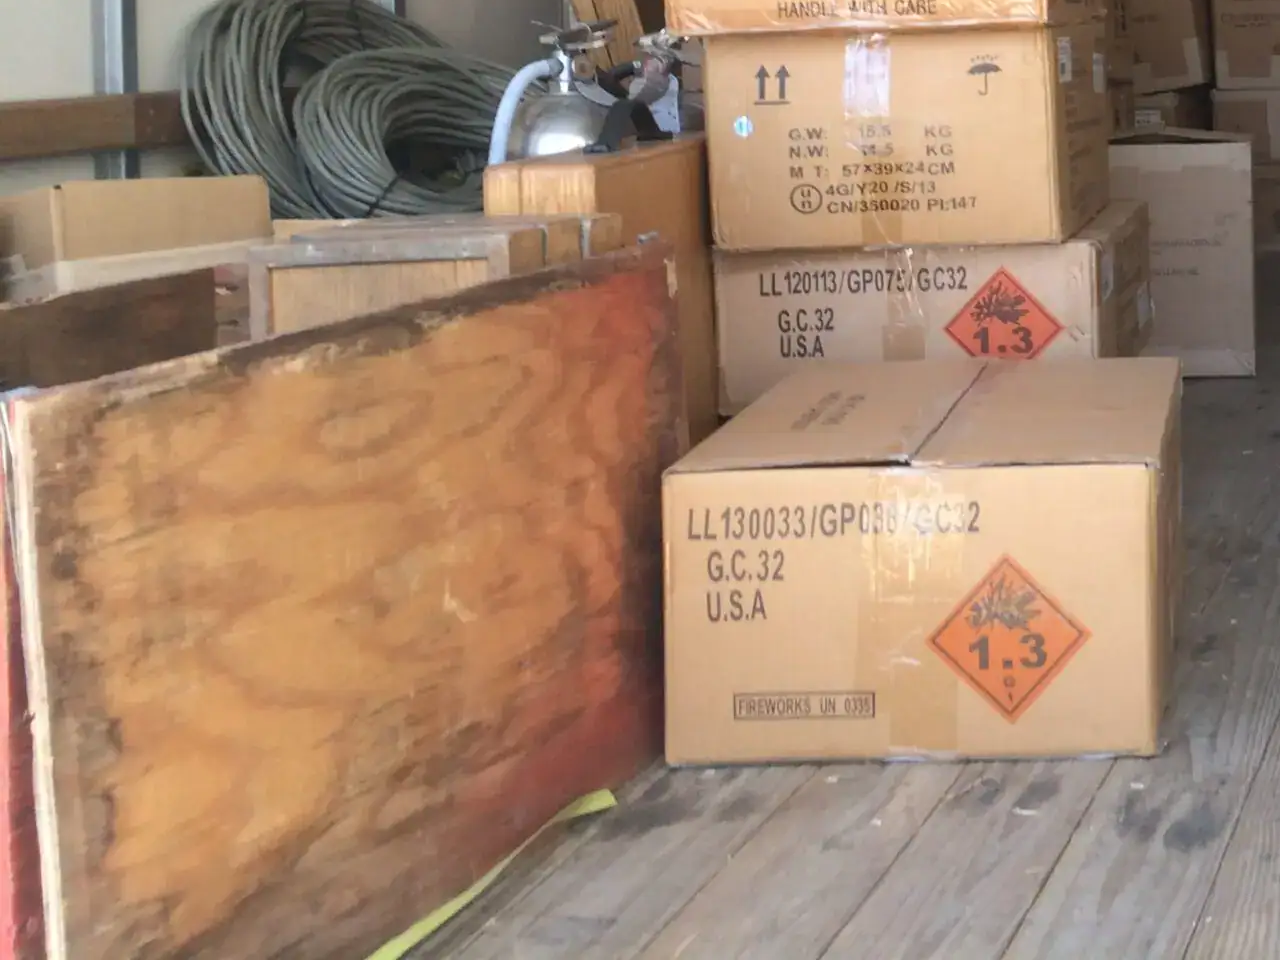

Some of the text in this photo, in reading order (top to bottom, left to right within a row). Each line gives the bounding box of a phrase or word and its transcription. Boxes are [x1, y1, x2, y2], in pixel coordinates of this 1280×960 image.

[789, 127, 828, 141] G.W:
[923, 125, 953, 138] KG
[789, 145, 830, 159] N.W:
[926, 143, 955, 157] KG
[778, 307, 835, 332] G.C.32
[779, 334, 825, 359] U.S.A
[972, 326, 1034, 355] 1.3
[707, 549, 785, 583] G.C.32
[707, 589, 768, 622] U.S.A
[967, 633, 1048, 670] 1.3
[738, 695, 871, 716] FIREWORKS UN 0335
